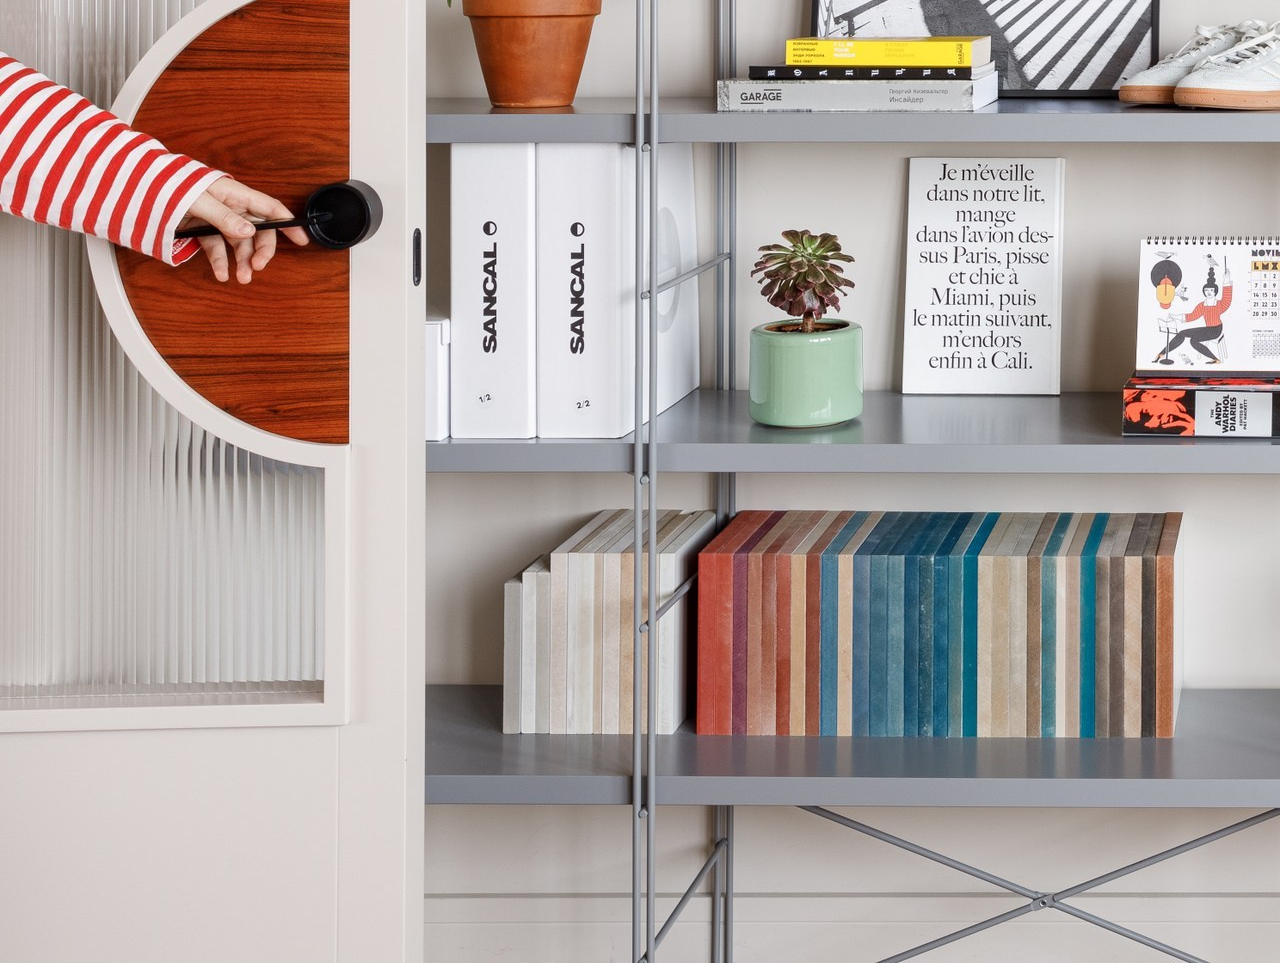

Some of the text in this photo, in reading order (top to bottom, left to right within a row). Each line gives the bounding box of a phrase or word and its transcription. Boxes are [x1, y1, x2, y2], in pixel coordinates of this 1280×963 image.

[740, 92, 782, 101] GARAGE
[939, 164, 1034, 181] Je m'éveille
[927, 185, 1045, 204] dans notre lit,
[956, 209, 1015, 228] mange
[916, 226, 1053, 242] dans l'avion des-
[920, 247, 1049, 269] sus Paris, pisse
[949, 270, 966, 284] et
[970, 268, 1004, 284] chie
[483, 242, 497, 353] SANCAL
[570, 243, 585, 354] SANCAL
[930, 288, 1036, 310] Miami, puis
[913, 310, 1052, 329] le matin suivant,
[943, 330, 1021, 348] m'endors
[929, 351, 972, 369] enfin
[992, 351, 1032, 369] Cali.
[479, 394, 491, 403] 1/2
[576, 400, 590, 408] 2/2
